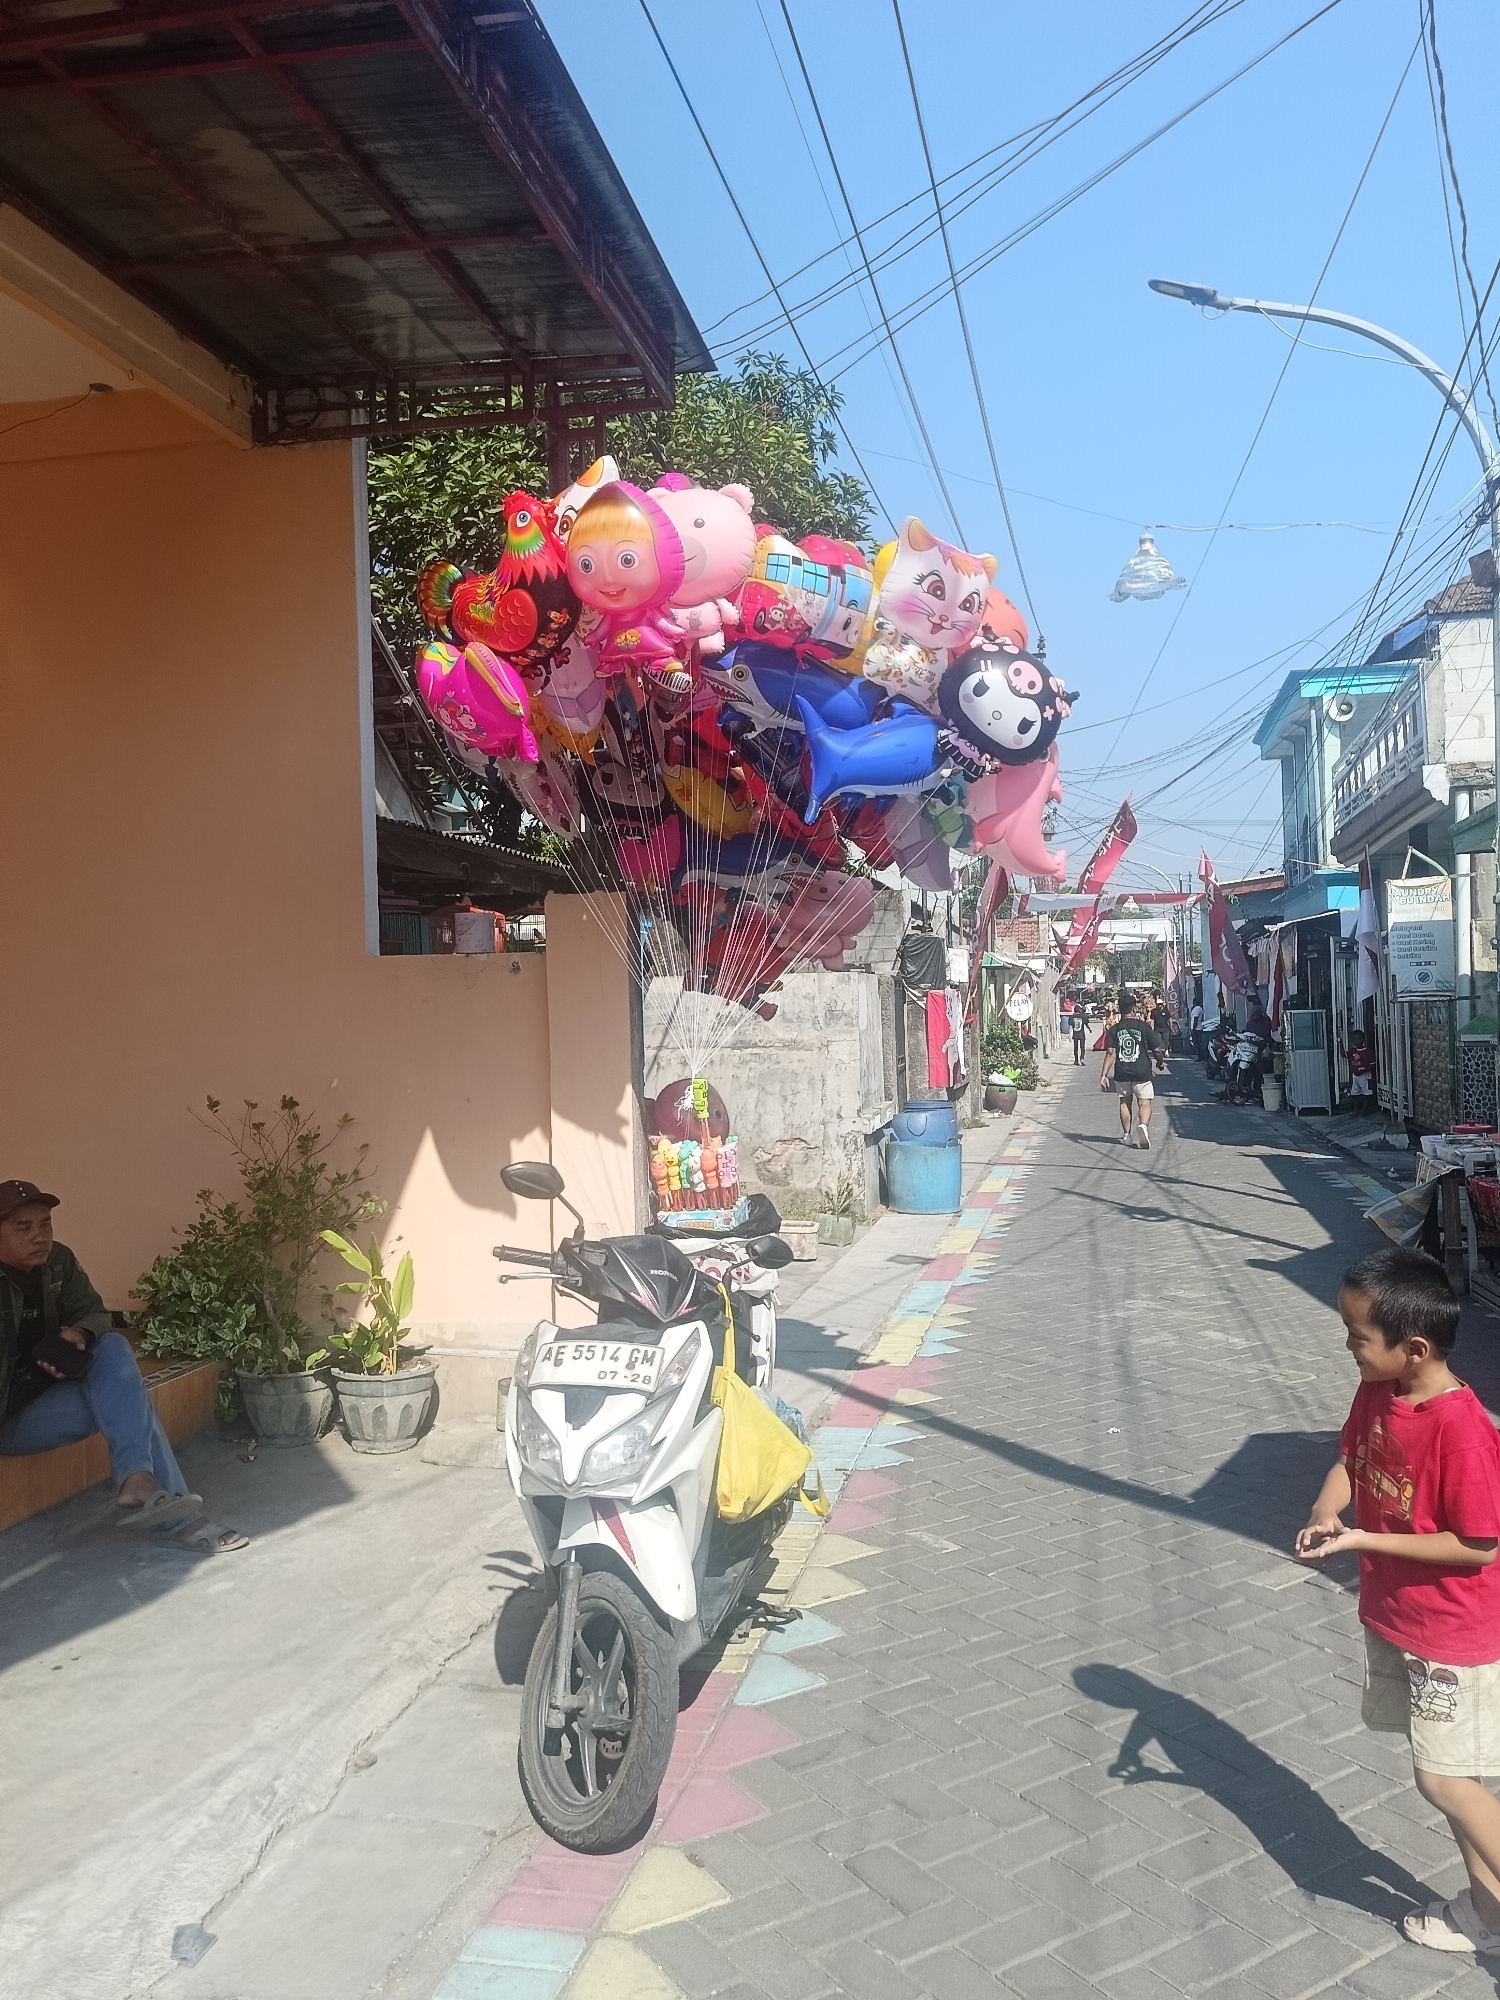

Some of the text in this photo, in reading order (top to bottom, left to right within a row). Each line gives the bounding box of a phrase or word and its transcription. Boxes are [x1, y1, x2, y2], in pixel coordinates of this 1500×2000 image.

[1122, 1036, 1136, 1058] 9
[650, 1269, 679, 1282] HONDA
[541, 1344, 657, 1366] AE 5514 GM
